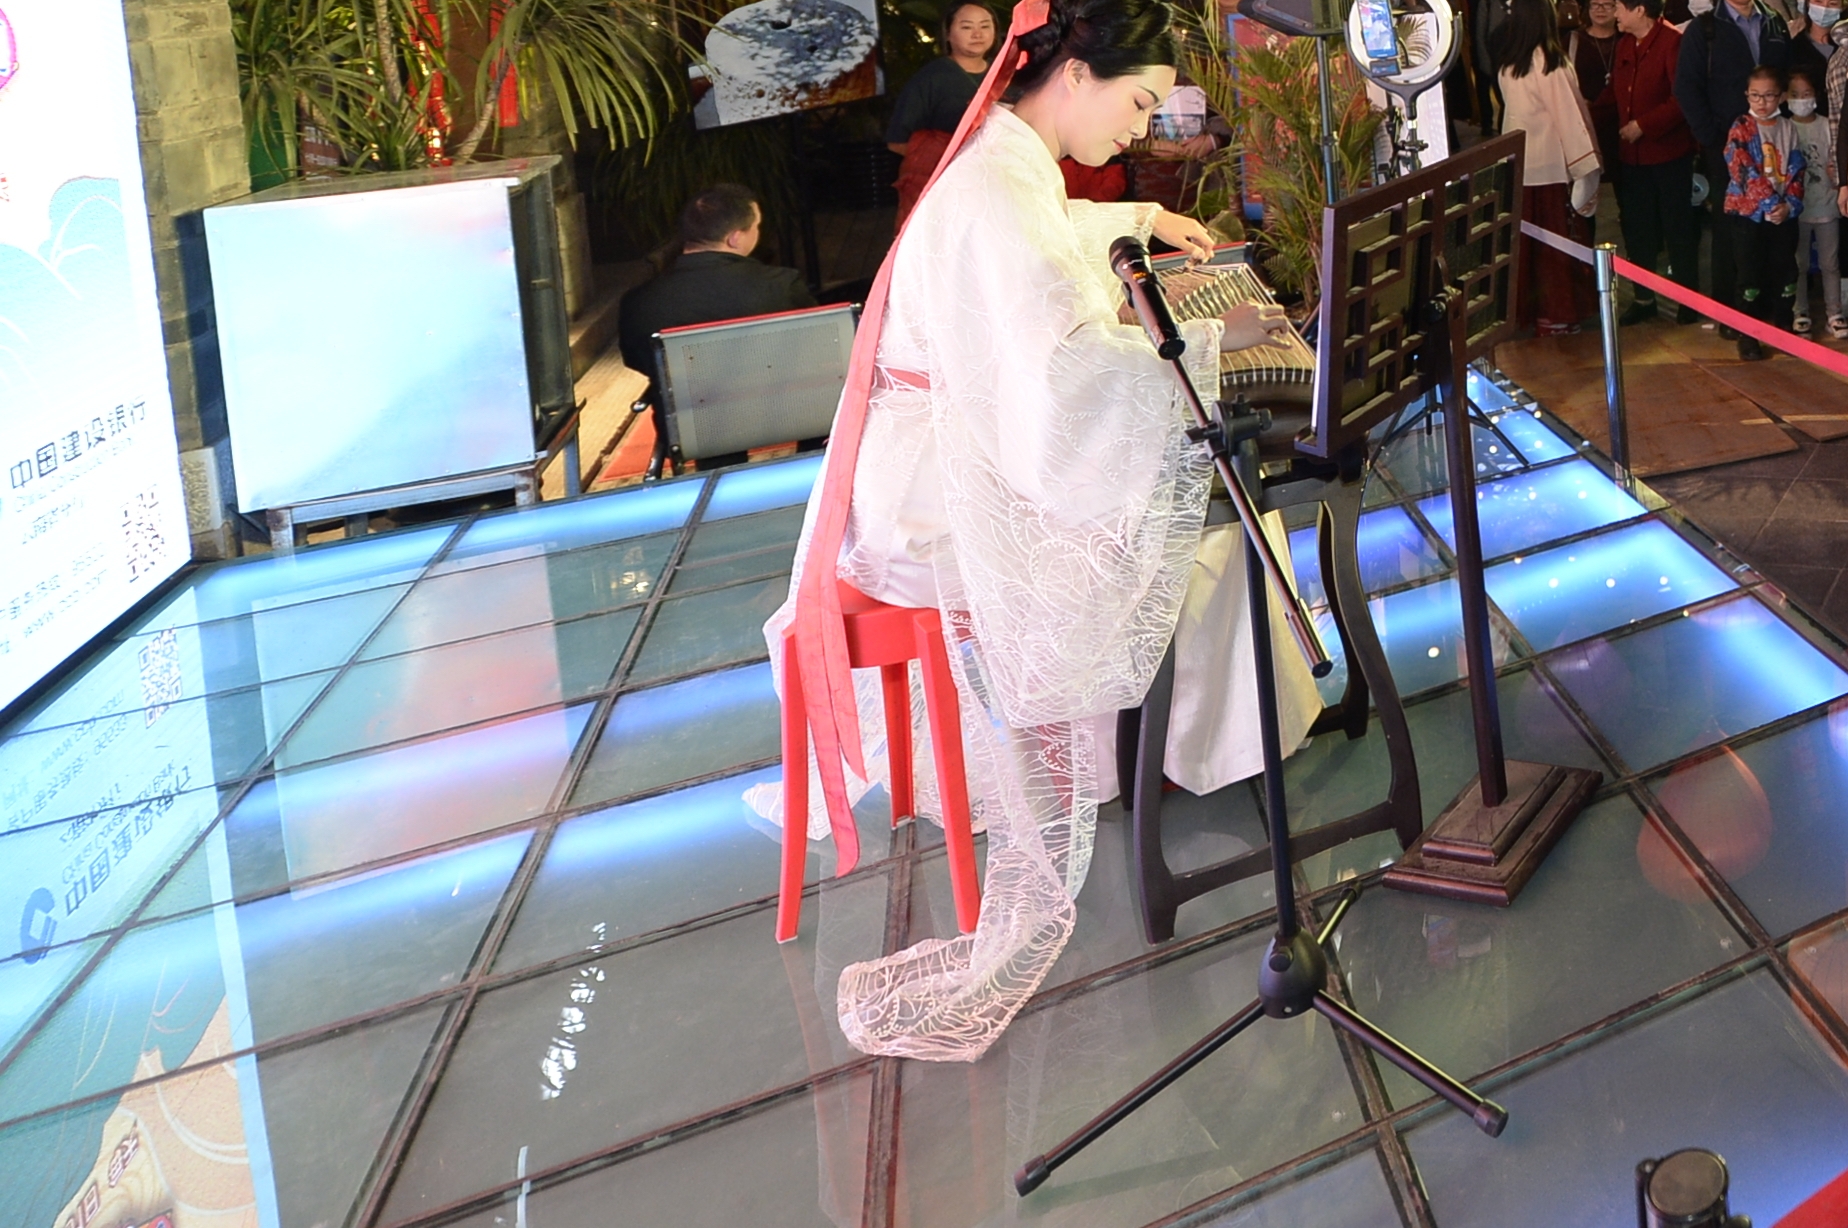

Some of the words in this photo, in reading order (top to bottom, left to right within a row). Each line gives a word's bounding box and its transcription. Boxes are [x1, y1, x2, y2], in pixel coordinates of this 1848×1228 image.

[10, 394, 147, 489] 中国建设银行
